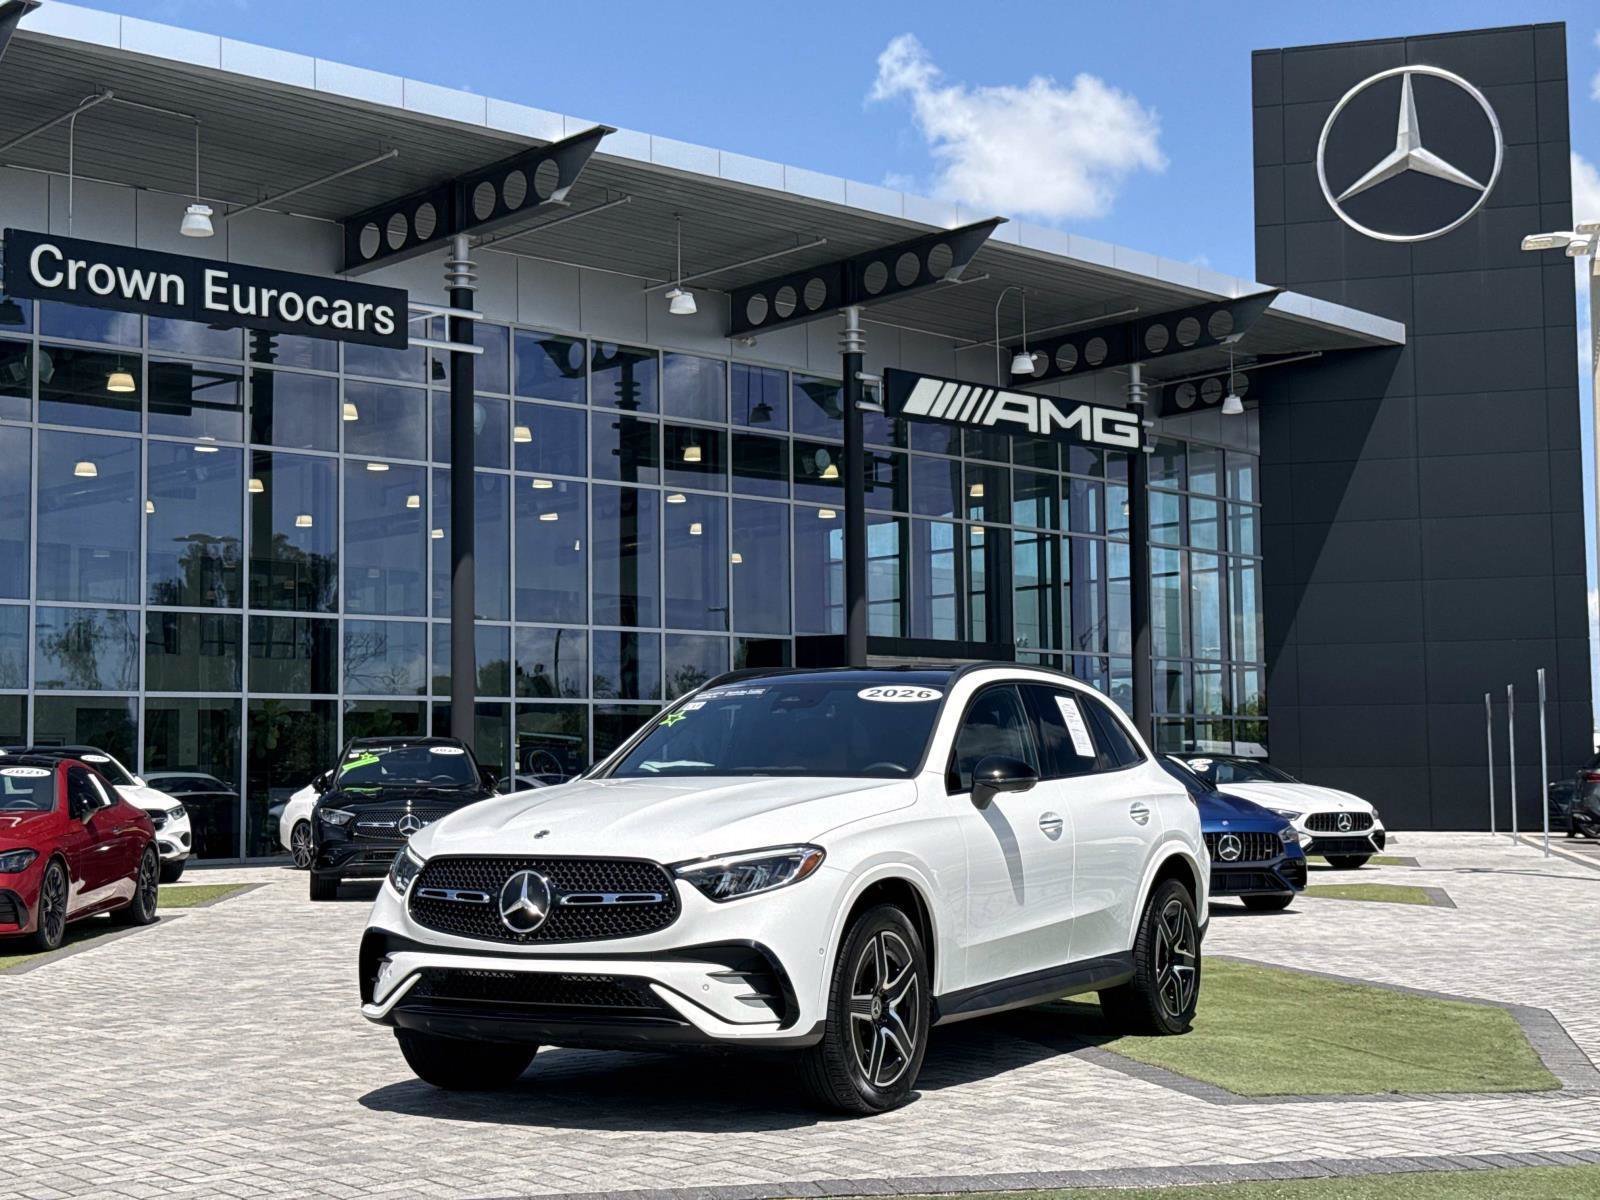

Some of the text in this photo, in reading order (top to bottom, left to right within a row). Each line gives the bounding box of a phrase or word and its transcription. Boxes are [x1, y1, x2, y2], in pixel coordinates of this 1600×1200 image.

[29, 243, 396, 335] Crown Eurocars
[982, 390, 1140, 449] AMG
[866, 688, 932, 699] 2026
